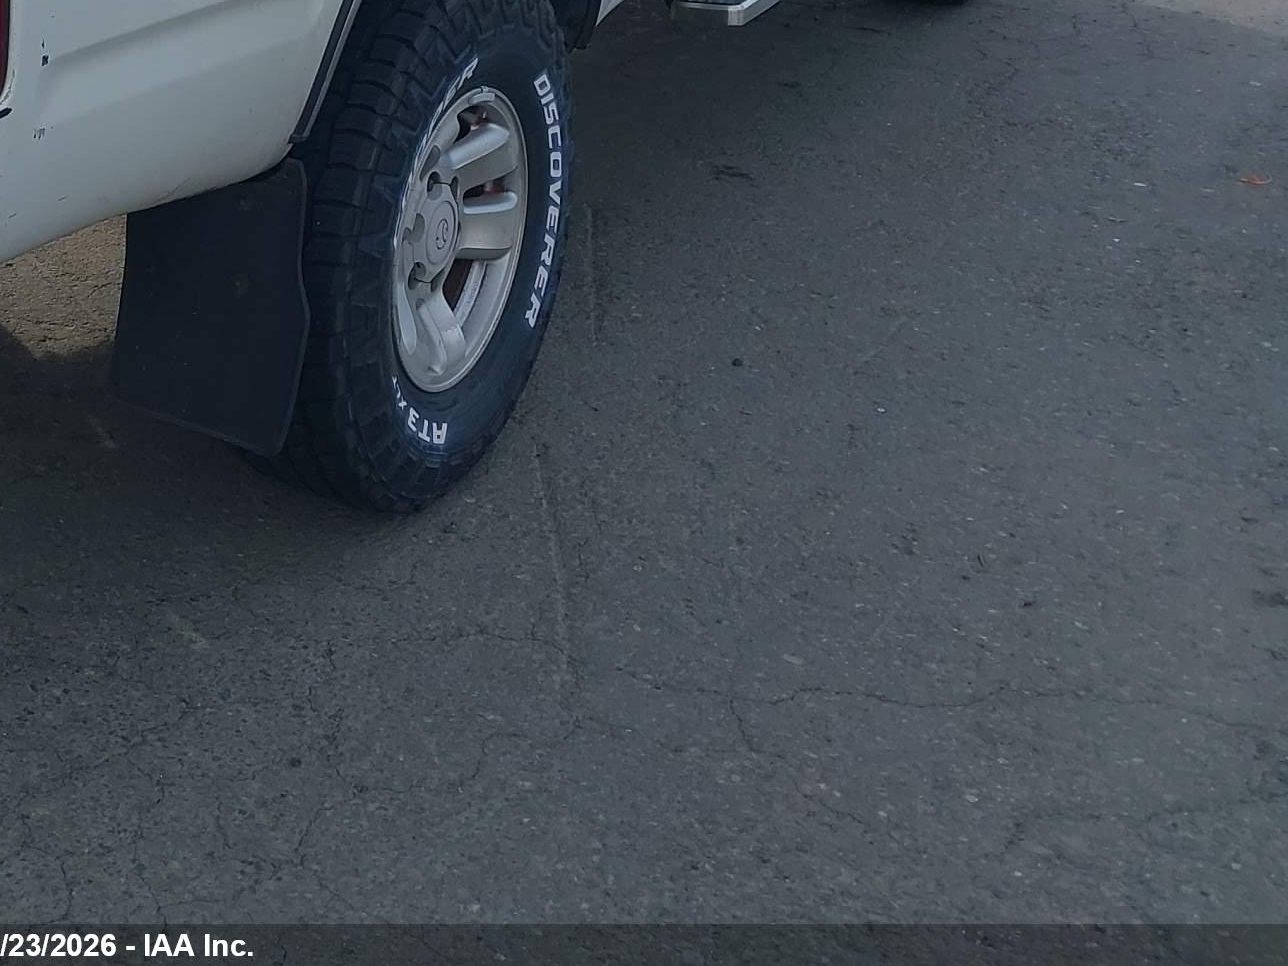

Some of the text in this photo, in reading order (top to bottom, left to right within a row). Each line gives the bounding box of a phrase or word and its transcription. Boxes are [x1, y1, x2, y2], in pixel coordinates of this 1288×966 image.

[524, 73, 563, 329] DISCOVERER
[392, 375, 448, 444] AT3 XLT
